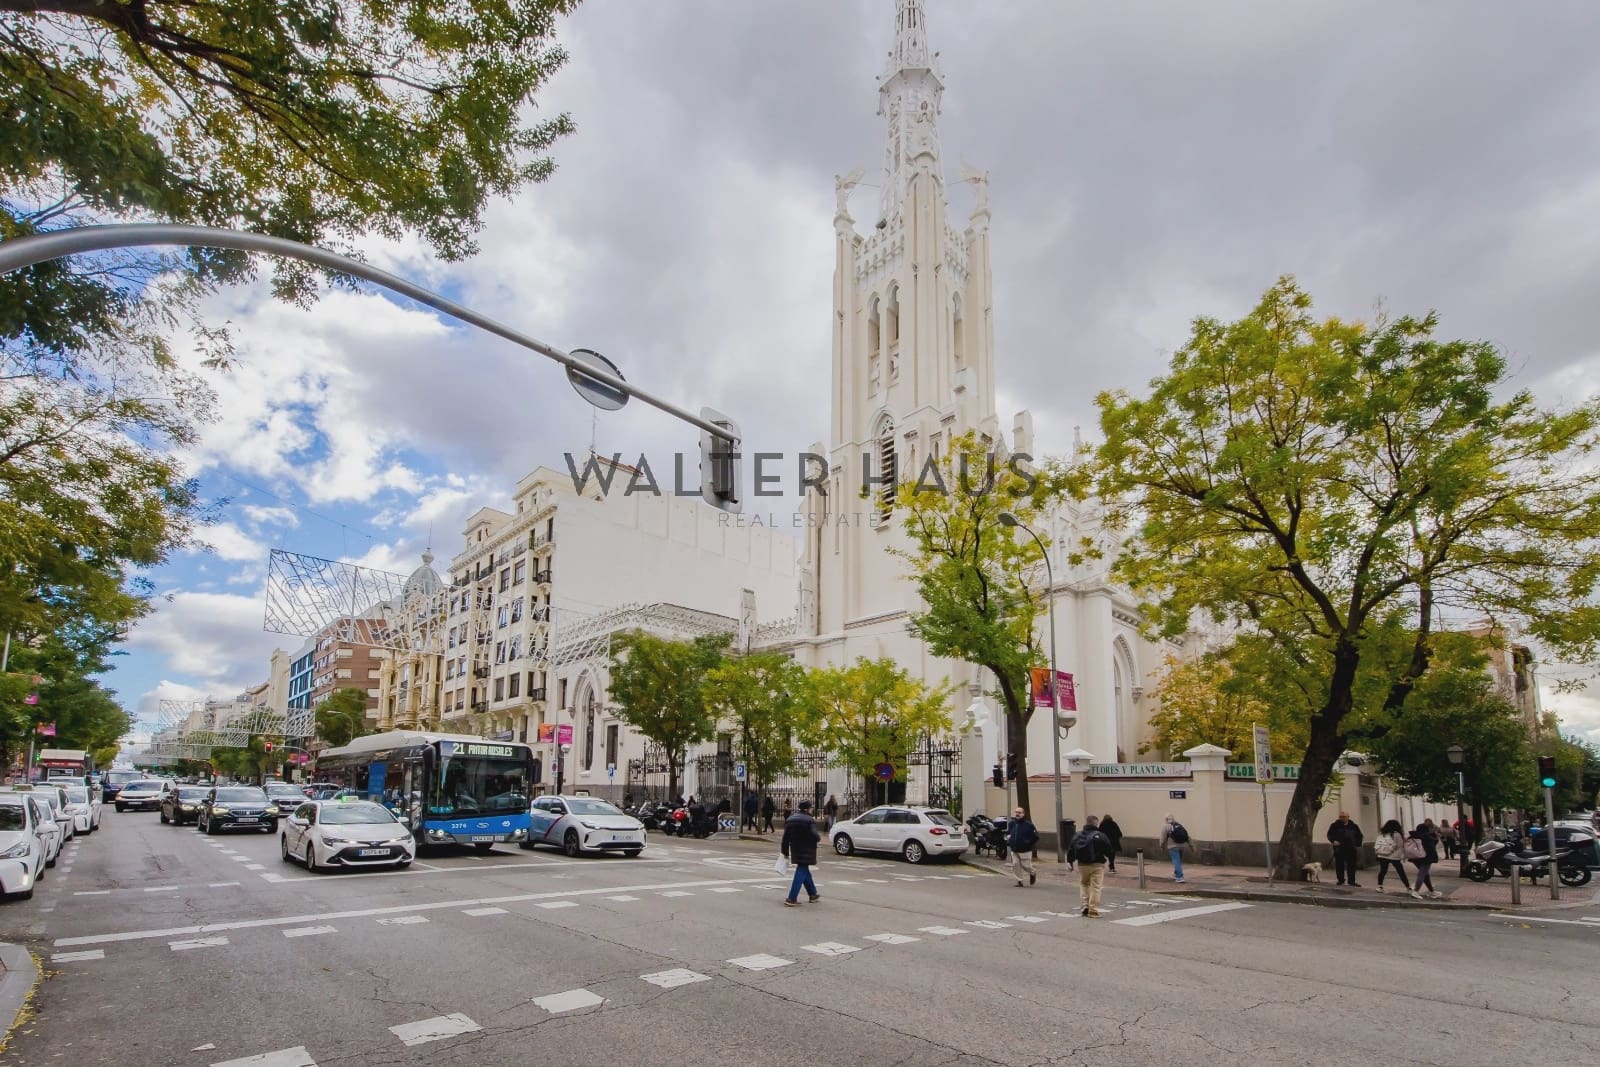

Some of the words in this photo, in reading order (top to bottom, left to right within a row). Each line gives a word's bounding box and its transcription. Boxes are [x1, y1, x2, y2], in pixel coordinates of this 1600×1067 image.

[453, 742, 465, 755] 21
[1092, 765, 1119, 775] FLORES
[1122, 765, 1127, 774] Y
[1130, 764, 1166, 774] PLANTAS
[1230, 765, 1255, 777] FLOR
